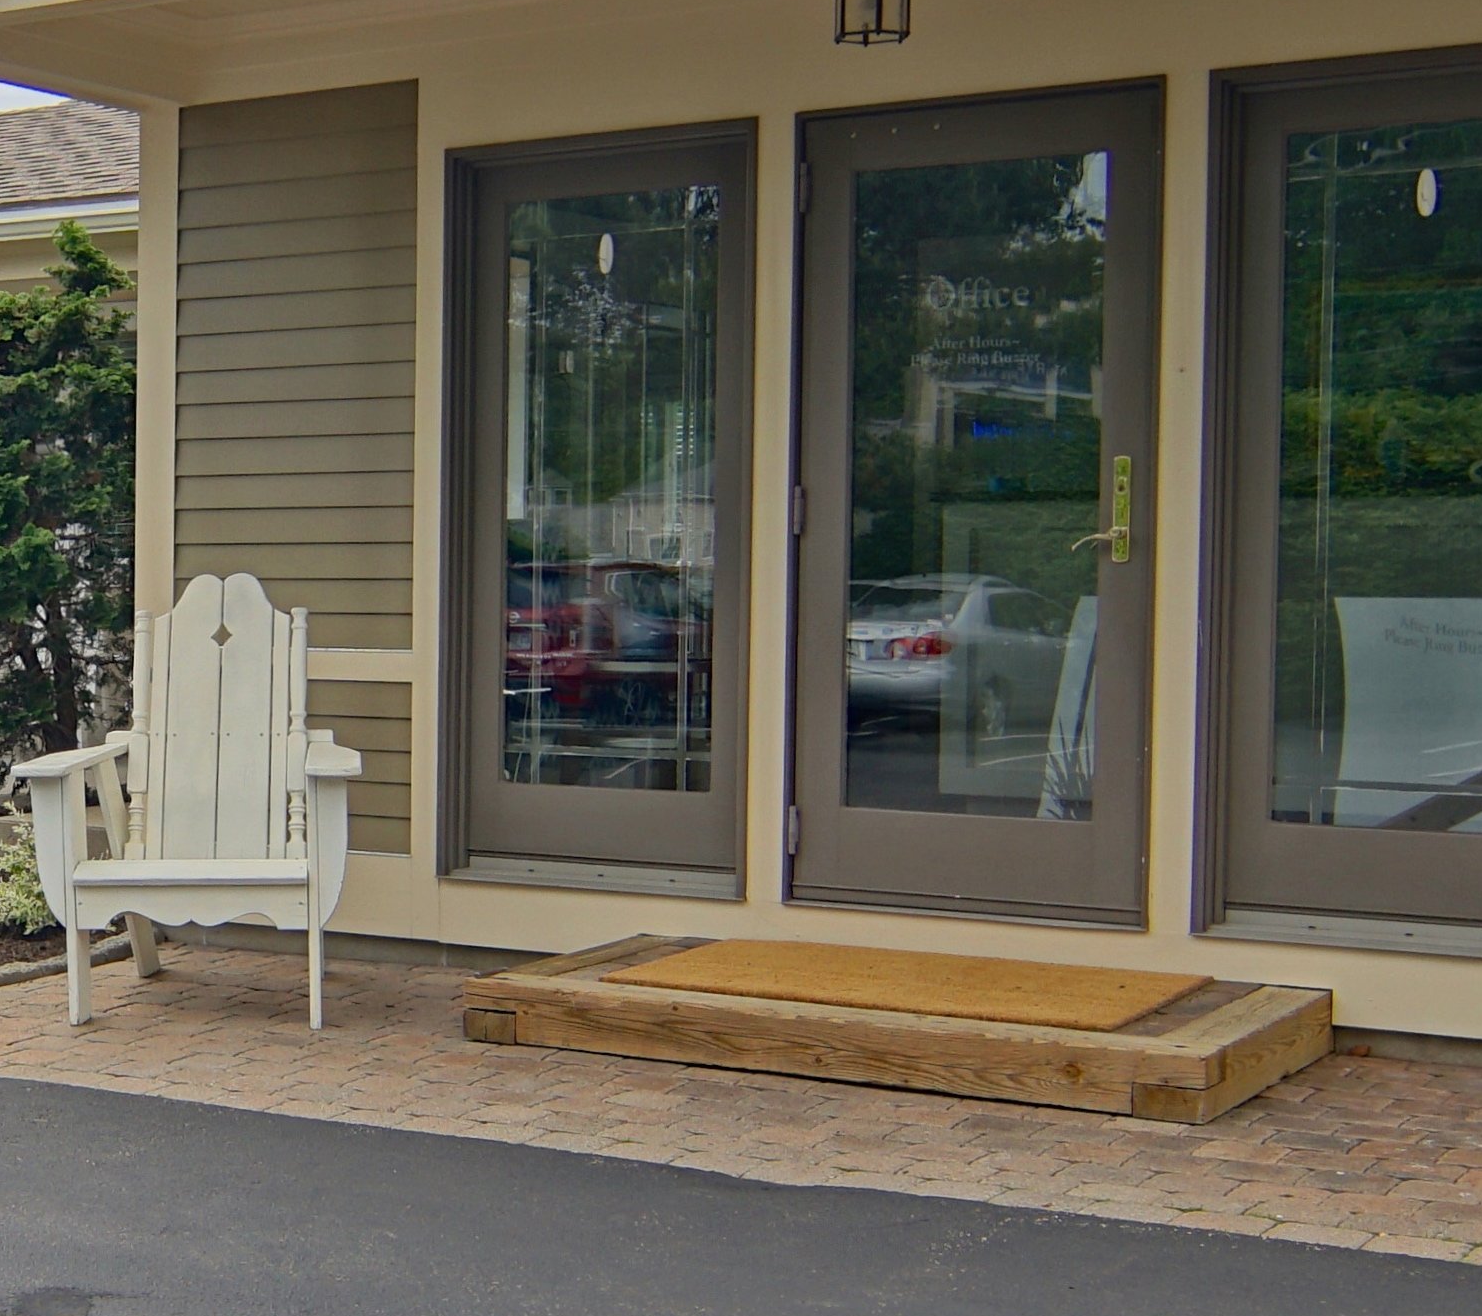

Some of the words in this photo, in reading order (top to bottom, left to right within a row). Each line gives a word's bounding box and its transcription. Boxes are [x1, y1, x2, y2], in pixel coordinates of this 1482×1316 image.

[926, 275, 1030, 309] Office
[932, 336, 965, 349] After
[957, 350, 987, 367] Ring
[990, 349, 1041, 364] Buzzer
